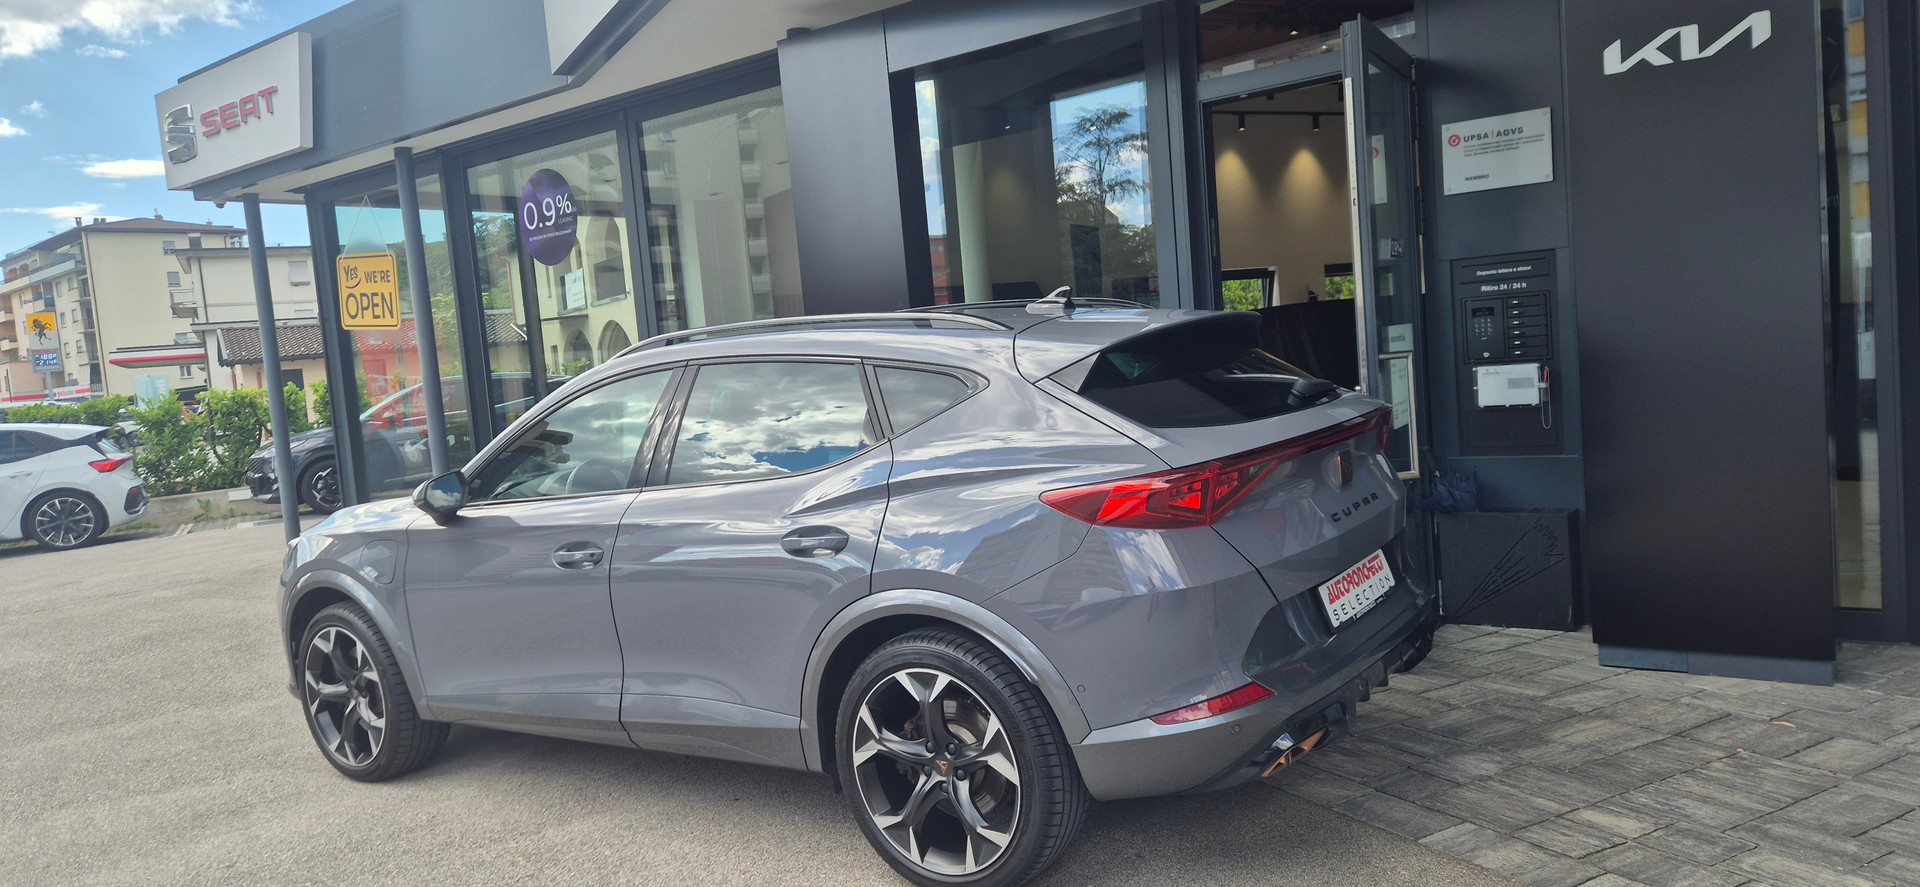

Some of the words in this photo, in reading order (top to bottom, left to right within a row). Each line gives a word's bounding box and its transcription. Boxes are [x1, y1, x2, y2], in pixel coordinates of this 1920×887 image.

[200, 85, 278, 138] SEAT
[1463, 132, 1489, 143] UPSA
[1496, 126, 1524, 138] AGVS
[1464, 174, 1490, 182] MEMBRO
[523, 192, 572, 231] 0.9%
[364, 270, 391, 284] WE'RE
[1481, 284, 1499, 292] Ritiro
[345, 291, 394, 320] OPEN
[1330, 492, 1380, 523] CUPRA
[1332, 574, 1392, 621] SELECTION
